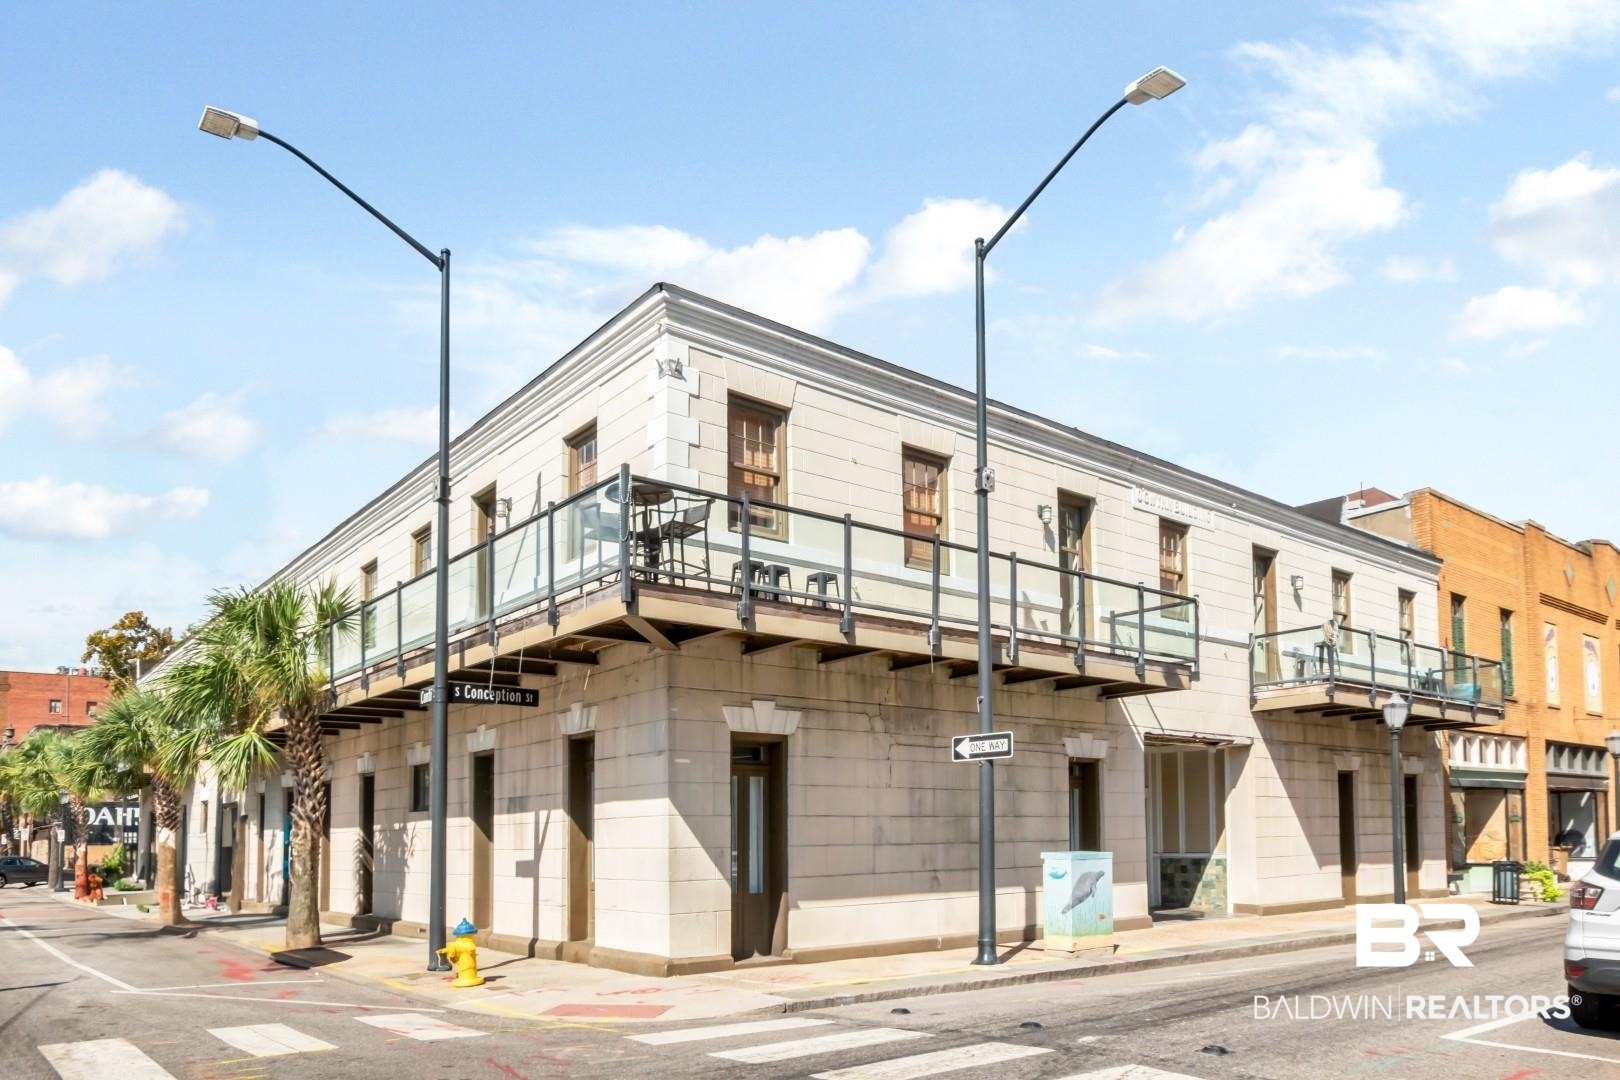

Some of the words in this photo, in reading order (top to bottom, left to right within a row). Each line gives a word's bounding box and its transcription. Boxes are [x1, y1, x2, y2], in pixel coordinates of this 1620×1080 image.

[455, 686, 460, 697] S
[464, 685, 521, 704] Conception
[525, 693, 533, 703] St
[969, 742, 986, 753] ONE
[989, 740, 1005, 751] WAY
